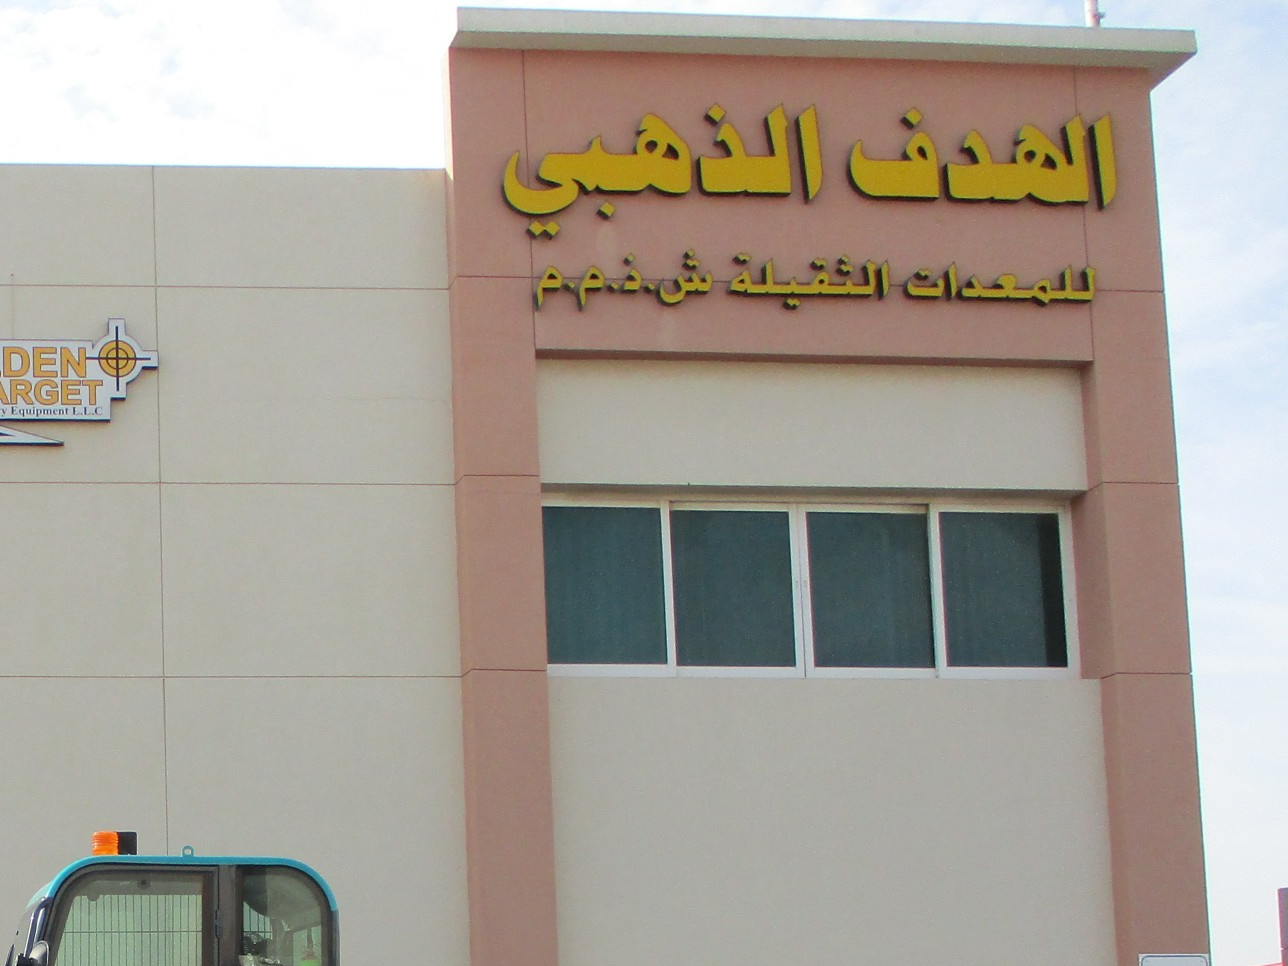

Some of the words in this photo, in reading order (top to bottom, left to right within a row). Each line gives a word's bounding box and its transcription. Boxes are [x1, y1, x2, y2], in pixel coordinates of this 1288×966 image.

[503, 103, 823, 239] الذهبي
[848, 107, 1117, 210] الهدف
[726, 256, 890, 310] الثقيلة
[902, 262, 1096, 306] للمعدات
[11, 406, 69, 417] Equipment
[72, 406, 103, 416] L.L.C
